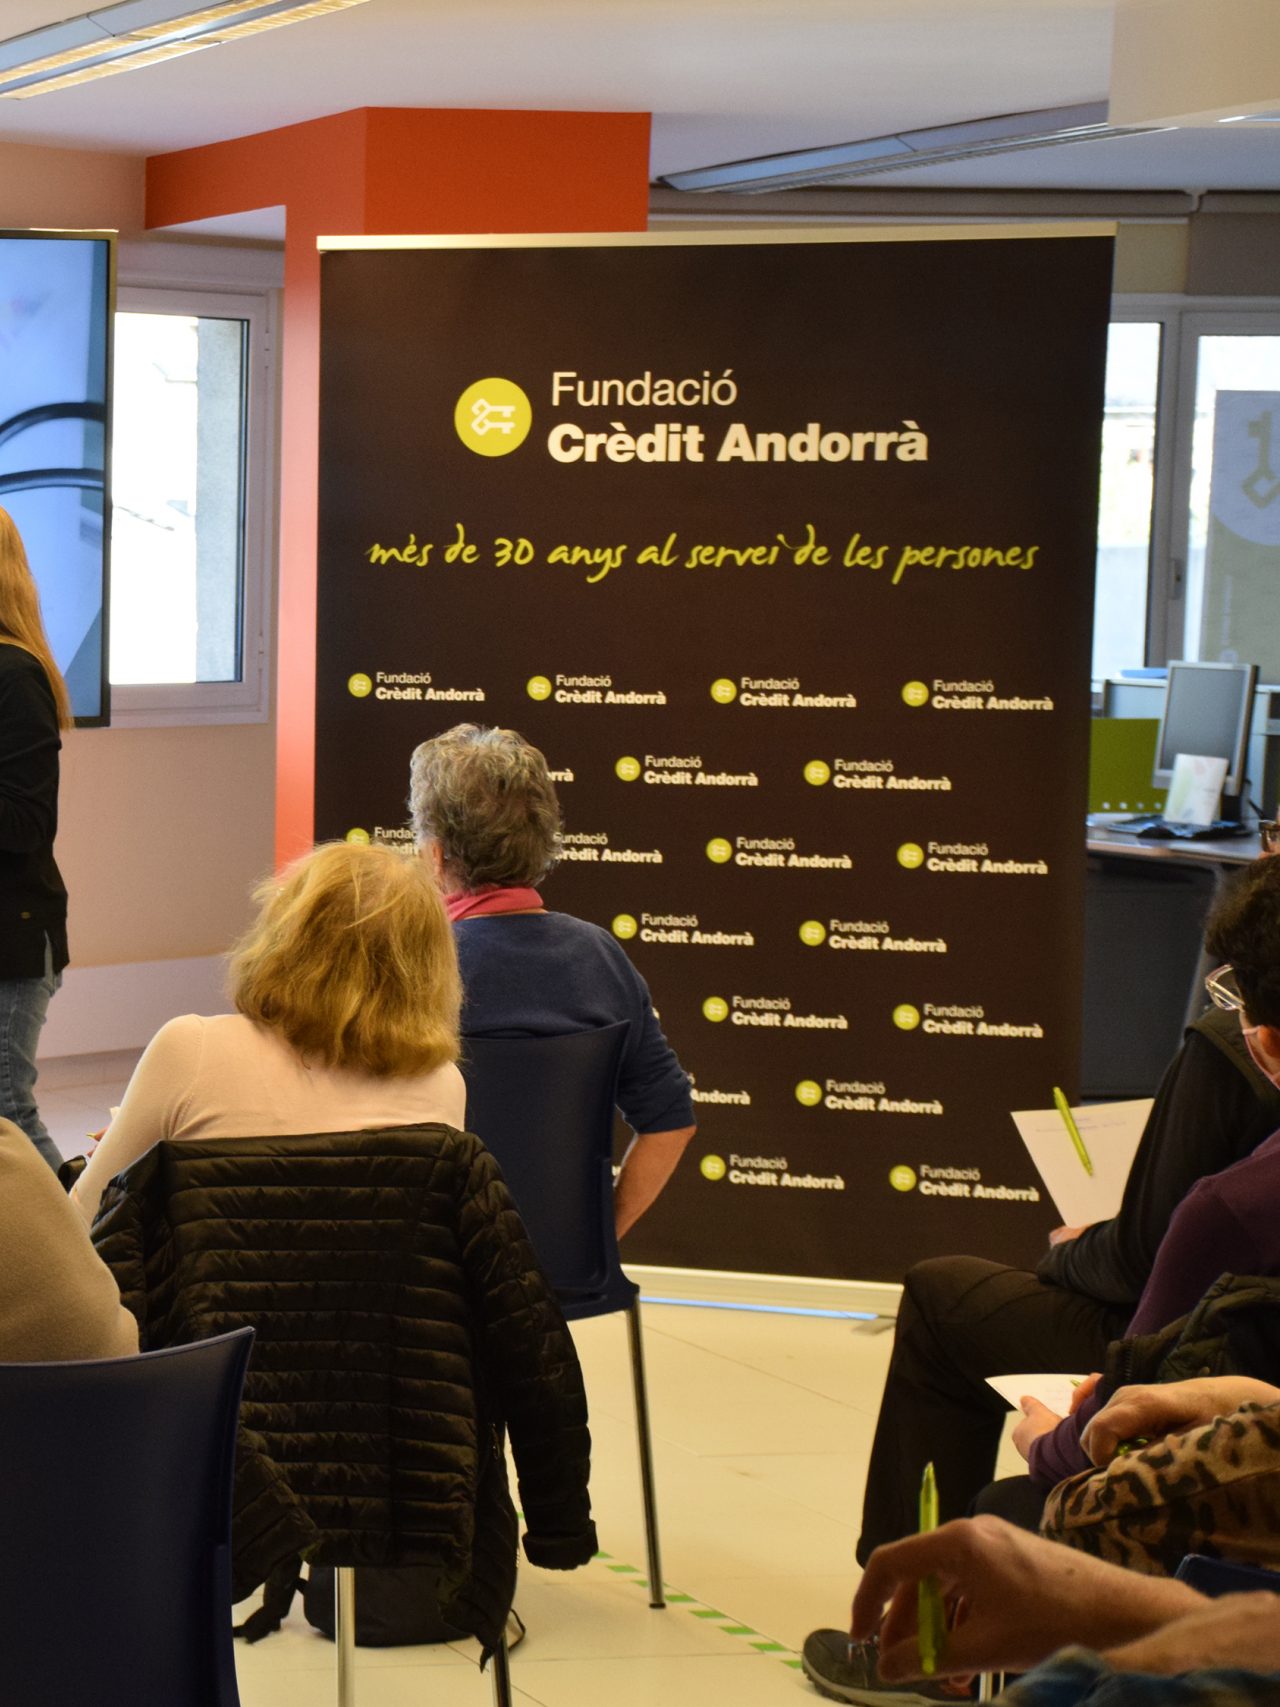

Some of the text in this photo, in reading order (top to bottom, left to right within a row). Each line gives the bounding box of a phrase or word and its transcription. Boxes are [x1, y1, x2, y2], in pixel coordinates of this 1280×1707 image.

[552, 369, 738, 406] Fundació
[547, 420, 929, 463] Crèdit Andorrà
[441, 522, 480, 564] de
[494, 537, 534, 567] 30
[547, 544, 627, 583] anys
[636, 532, 678, 567] al
[787, 523, 832, 566] de
[843, 533, 889, 569] les
[892, 545, 1040, 585] persones
[376, 672, 432, 686] Fundació
[555, 674, 612, 688] Fundació
[740, 677, 800, 691] Fundació
[933, 679, 994, 694] Fundació
[375, 688, 485, 701] Crèdit Andorrà
[555, 690, 667, 705] Crèdit Andorrà
[740, 693, 857, 708] Crèdit Andorrà
[932, 696, 1054, 710] Crèdit Andorrà
[644, 755, 702, 769] Fundació
[834, 759, 894, 771] Fundació
[643, 771, 759, 786] Crèdit Andorrà
[833, 774, 952, 791] Crèdit Andorrà
[374, 826, 417, 839] Fundac
[736, 837, 795, 849] Fundació
[928, 842, 988, 856] Fundació
[601, 848, 663, 863] Andorrà
[735, 852, 852, 869] Crèdit Andorrà
[926, 858, 1048, 874] Crèdit Andorrà
[641, 913, 698, 926] Fundació
[830, 919, 889, 934] Fundació
[640, 928, 754, 946] Crèdit Andorrà
[828, 936, 947, 953] Crèdit Andorrà
[733, 996, 791, 1009] Fundació
[923, 1003, 984, 1017] Fundació
[732, 1011, 848, 1029] Crèdit Andorrà
[922, 1019, 1043, 1038] Crèdit Andorrà
[826, 1079, 886, 1094] Fundació
[825, 1096, 943, 1114] Crèdit Andorrà
[730, 1154, 788, 1169] Fundació
[921, 1165, 980, 1180] Fundació
[728, 1171, 845, 1190] Crèdit Andorrà
[920, 1181, 1040, 1201] Crèdit Andorrà
